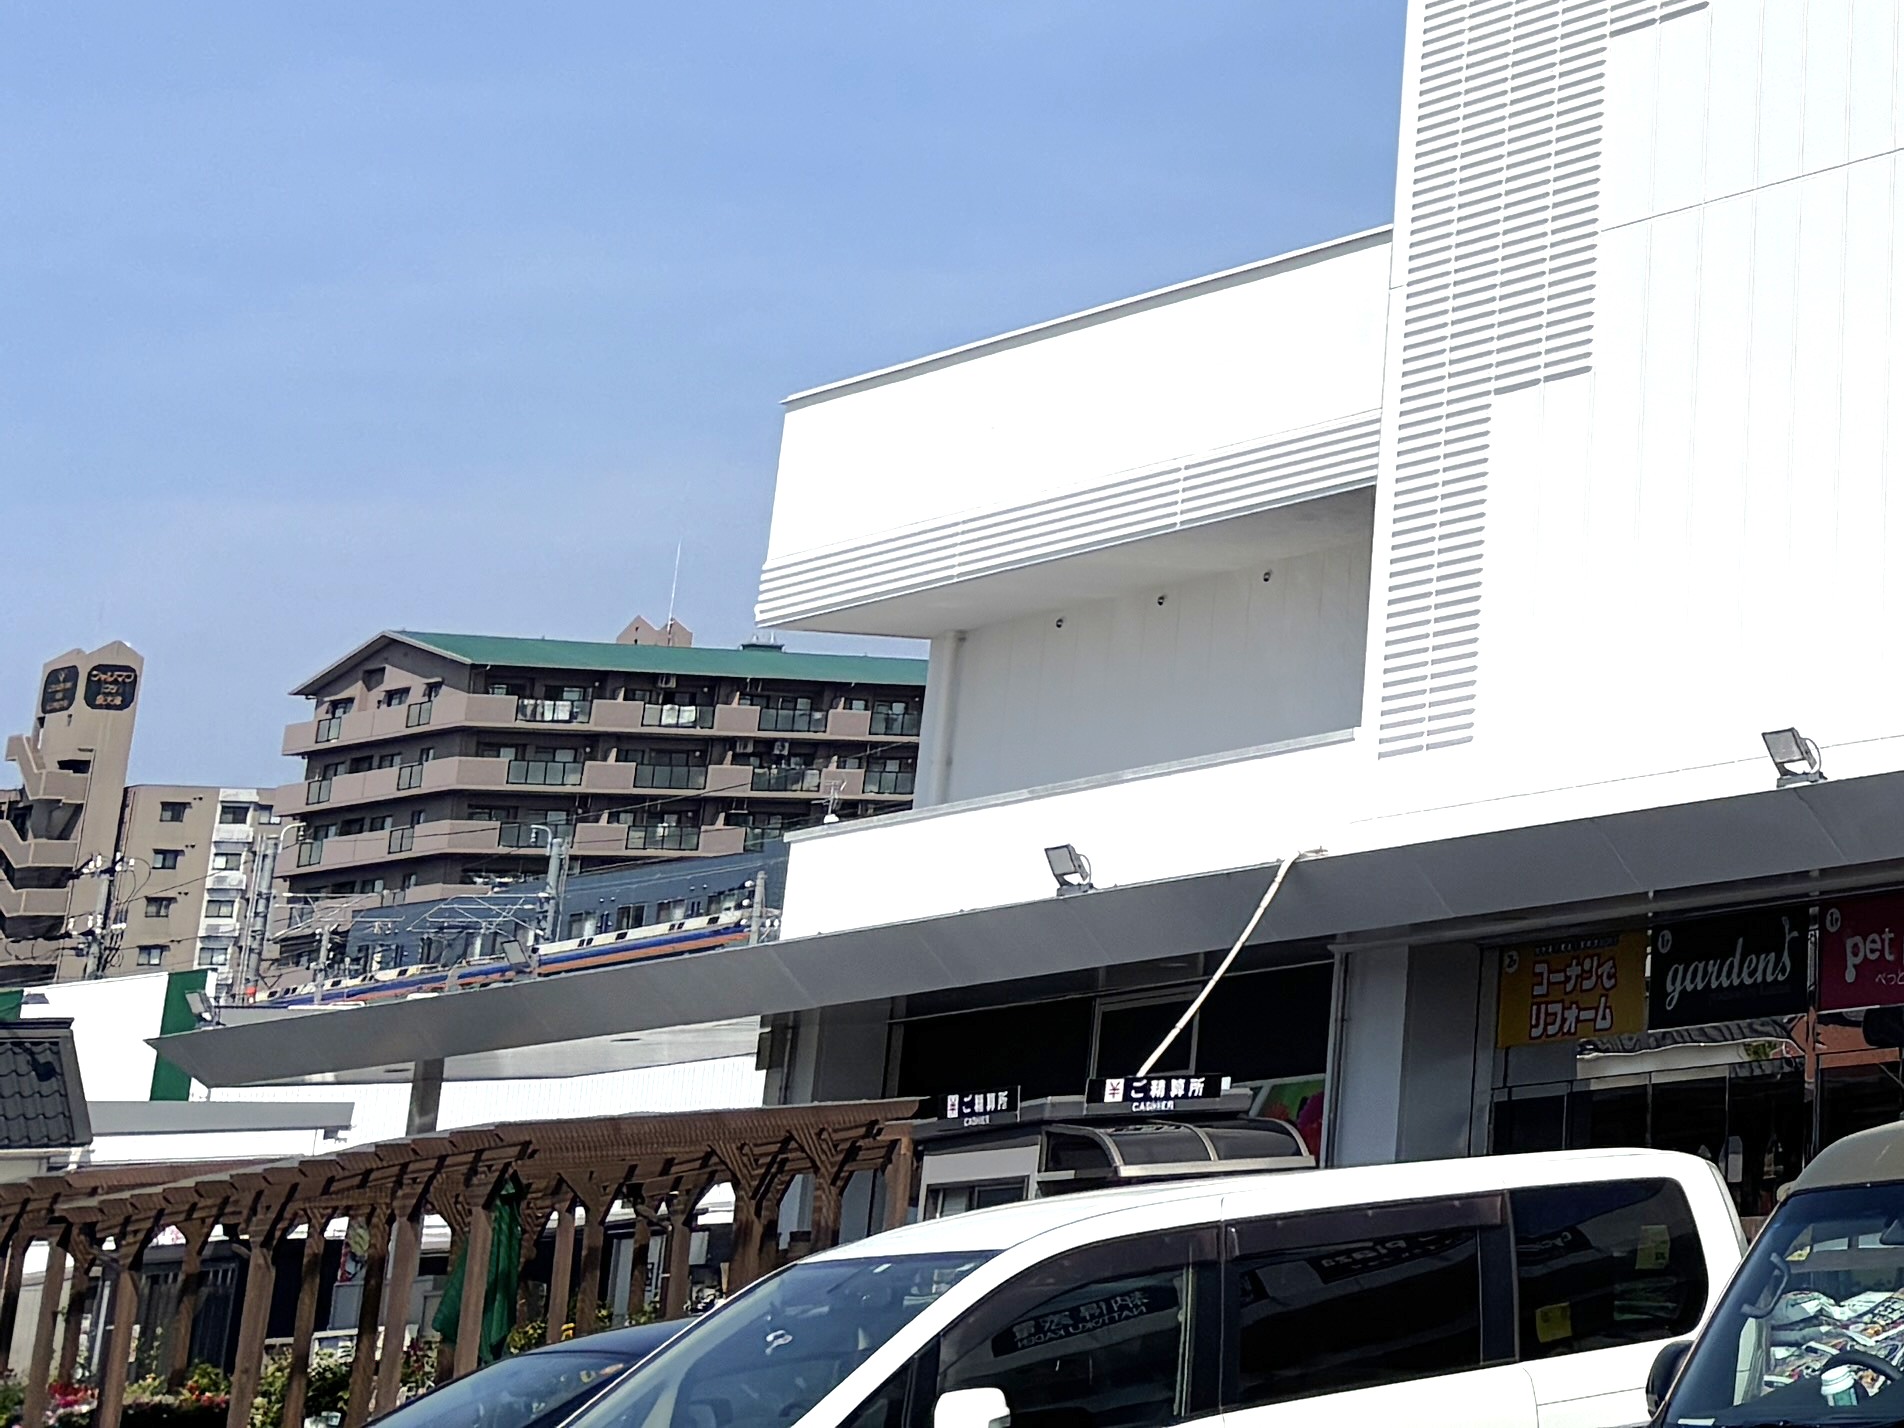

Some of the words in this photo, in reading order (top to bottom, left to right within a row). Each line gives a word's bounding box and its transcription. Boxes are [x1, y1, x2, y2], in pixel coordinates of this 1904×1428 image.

[1532, 953, 1618, 995] コーナンで
[1665, 916, 1799, 1011] gardens
[1844, 927, 1895, 983] pet
[1529, 996, 1613, 1039] リフォーム
